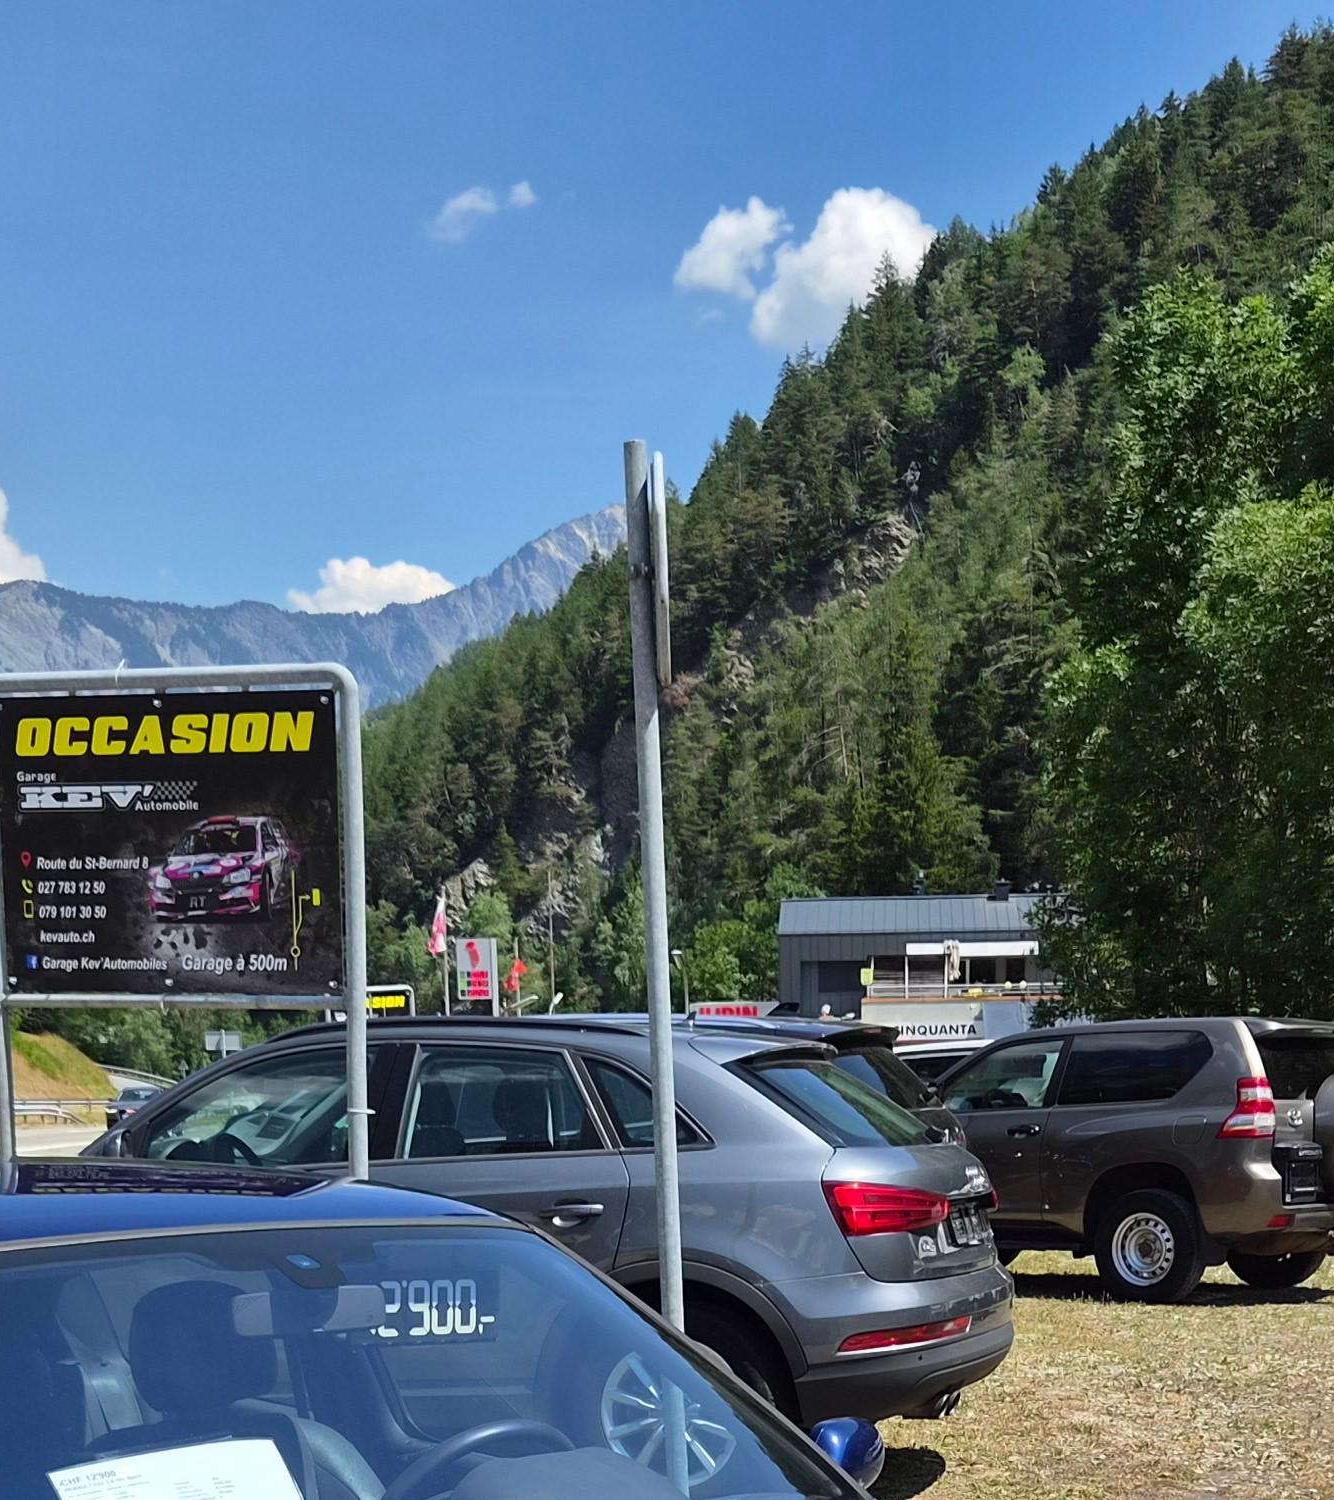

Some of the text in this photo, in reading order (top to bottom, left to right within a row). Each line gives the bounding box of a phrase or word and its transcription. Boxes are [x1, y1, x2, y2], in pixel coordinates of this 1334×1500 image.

[15, 711, 315, 757] OCCASION
[17, 771, 57, 783] Garage
[135, 800, 199, 811] Automobile
[37, 856, 149, 870] Route du St-Bernard 8
[38, 881, 106, 894] 027 783 12 50
[39, 905, 107, 919] 079 101 30 50
[40, 930, 96, 943] kevauto.ch
[42, 956, 168, 972] Garage Kev'Automobiles
[182, 954, 288, 976] Garage à 500m
[897, 1024, 977, 1036] INQUANTA
